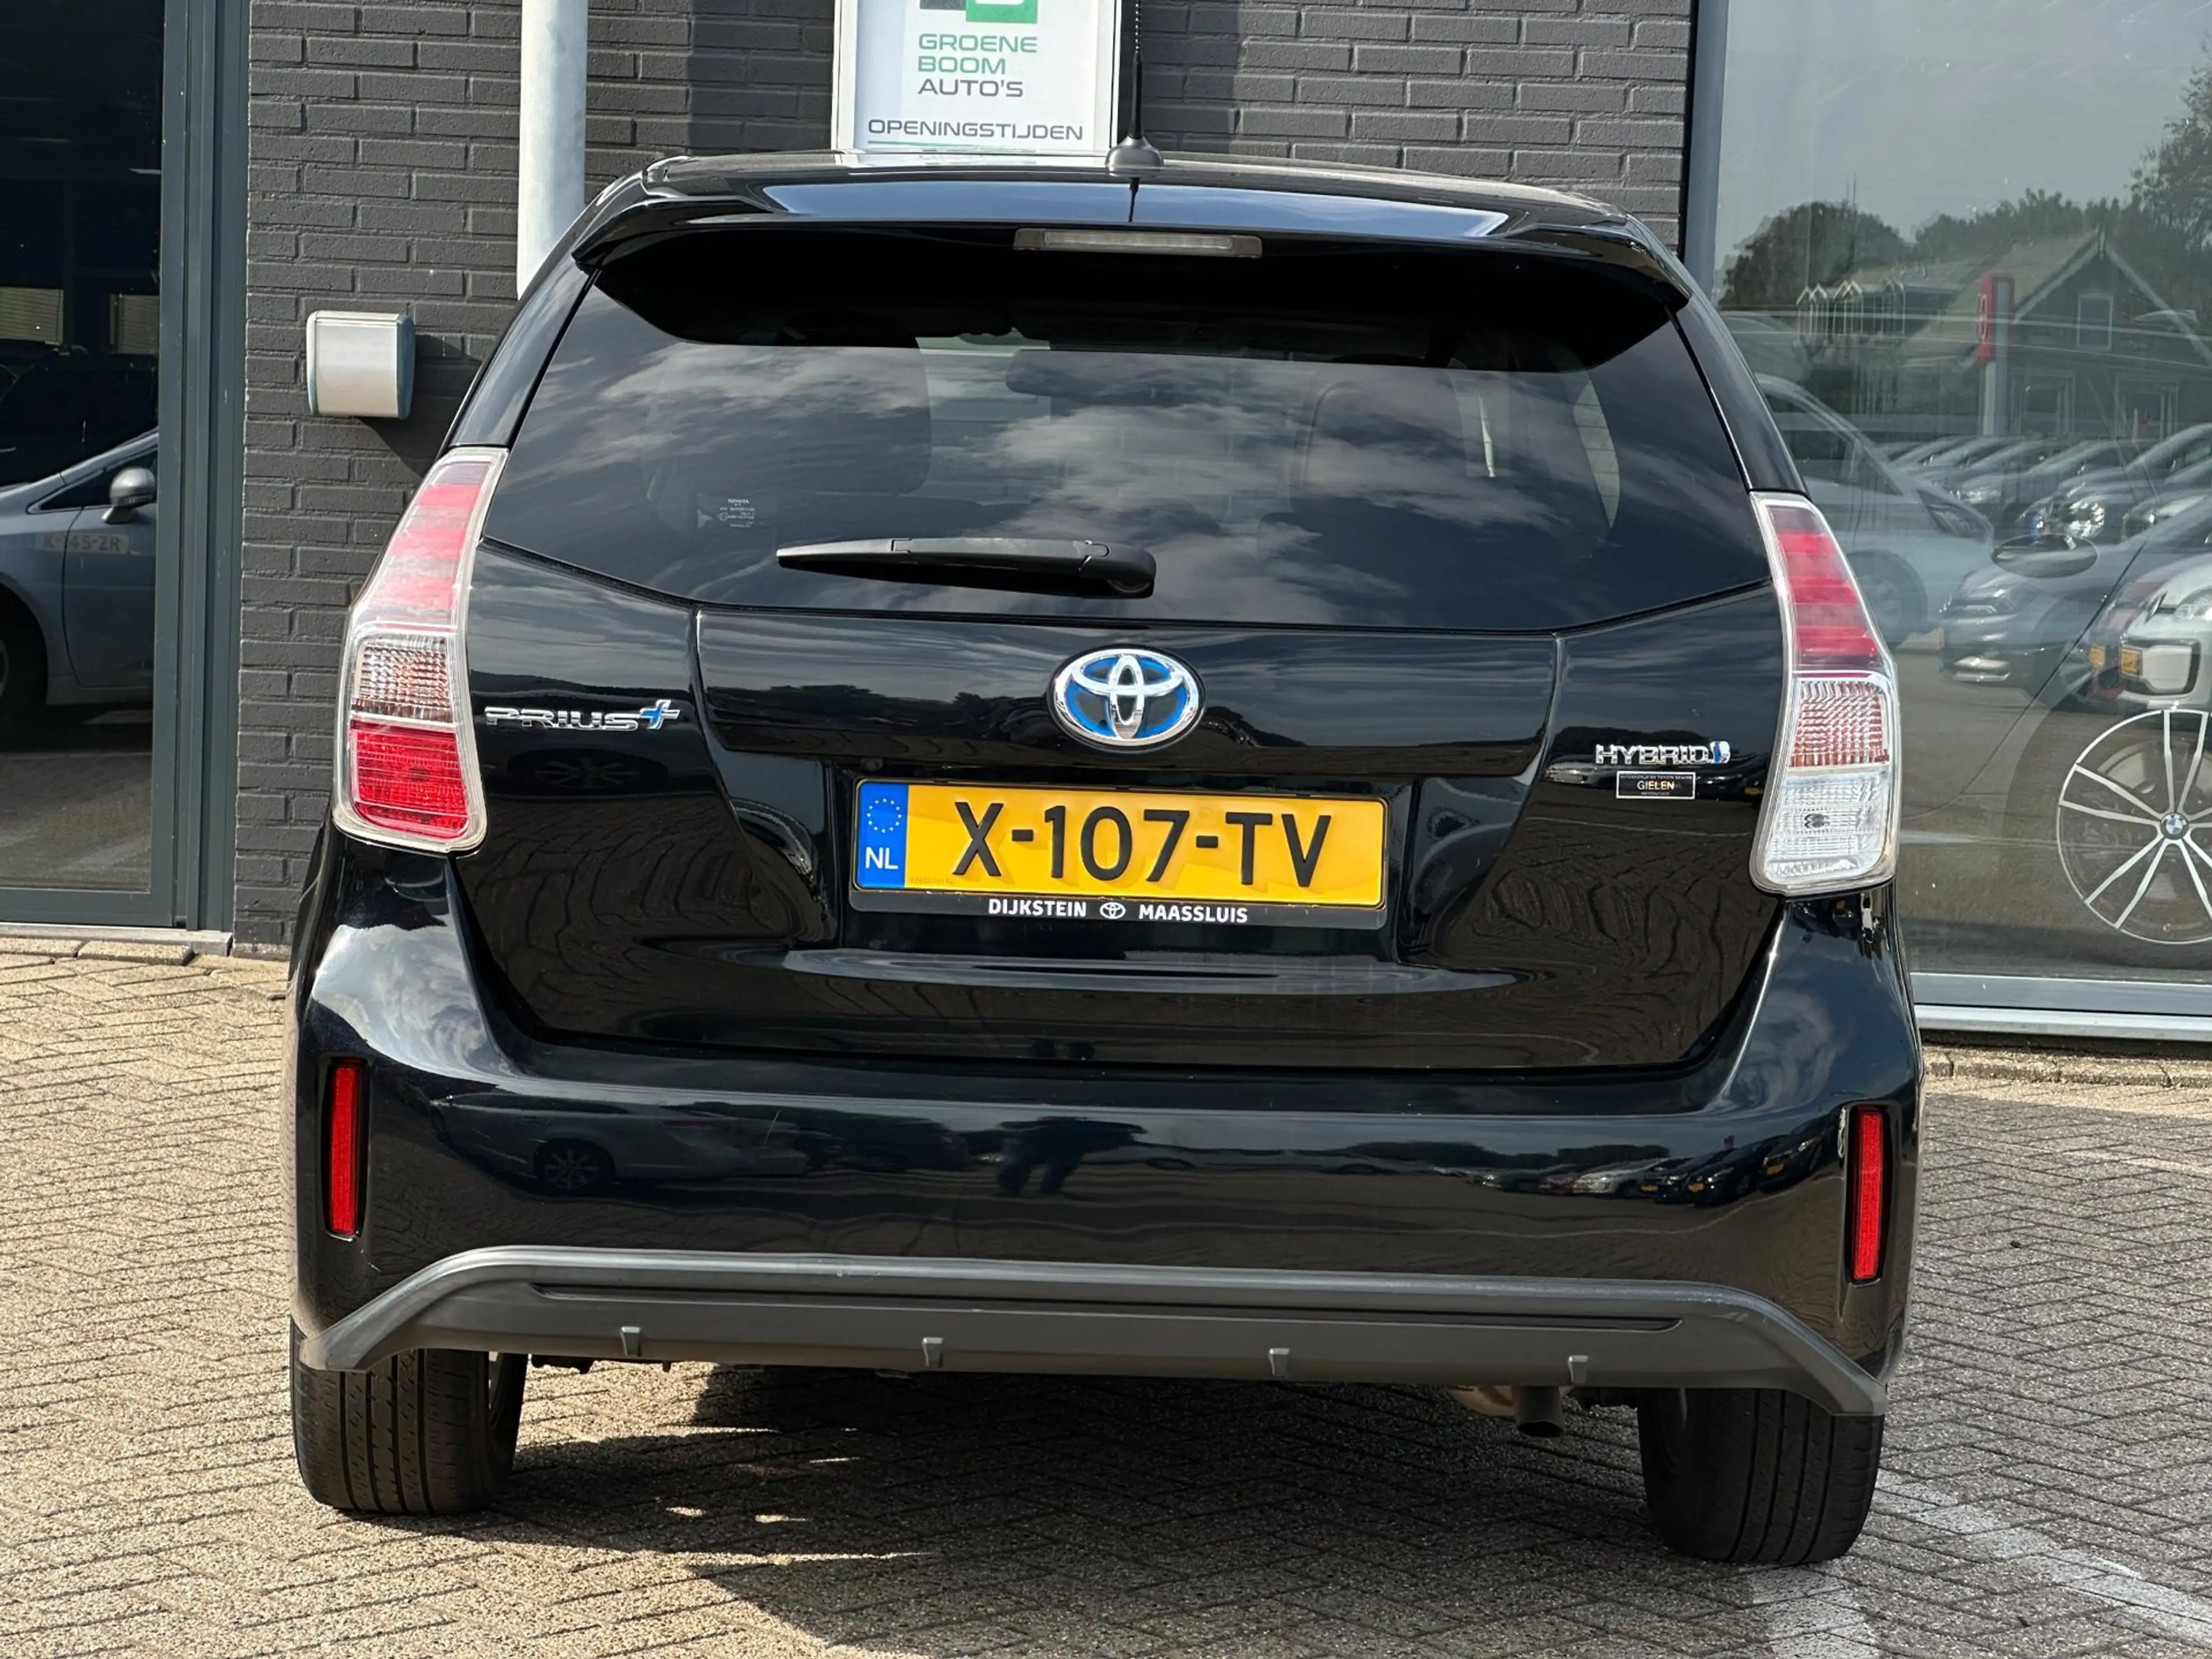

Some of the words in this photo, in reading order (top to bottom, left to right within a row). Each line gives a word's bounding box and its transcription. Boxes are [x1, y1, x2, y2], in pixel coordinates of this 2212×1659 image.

[919, 33, 1037, 53] GROENE
[918, 56, 1006, 74] BOOM
[918, 79, 1024, 97] AUTO'S
[868, 119, 1083, 140] OPENINGSTIJDEN
[1596, 744, 1712, 765] HYBRID
[1637, 781, 1675, 790] GIELEN
[953, 802, 1331, 888] X-107-TV
[865, 848, 899, 870] NL
[988, 899, 1087, 918] DIJKSTEIN
[1139, 905, 1248, 923] MAASSLUIS
